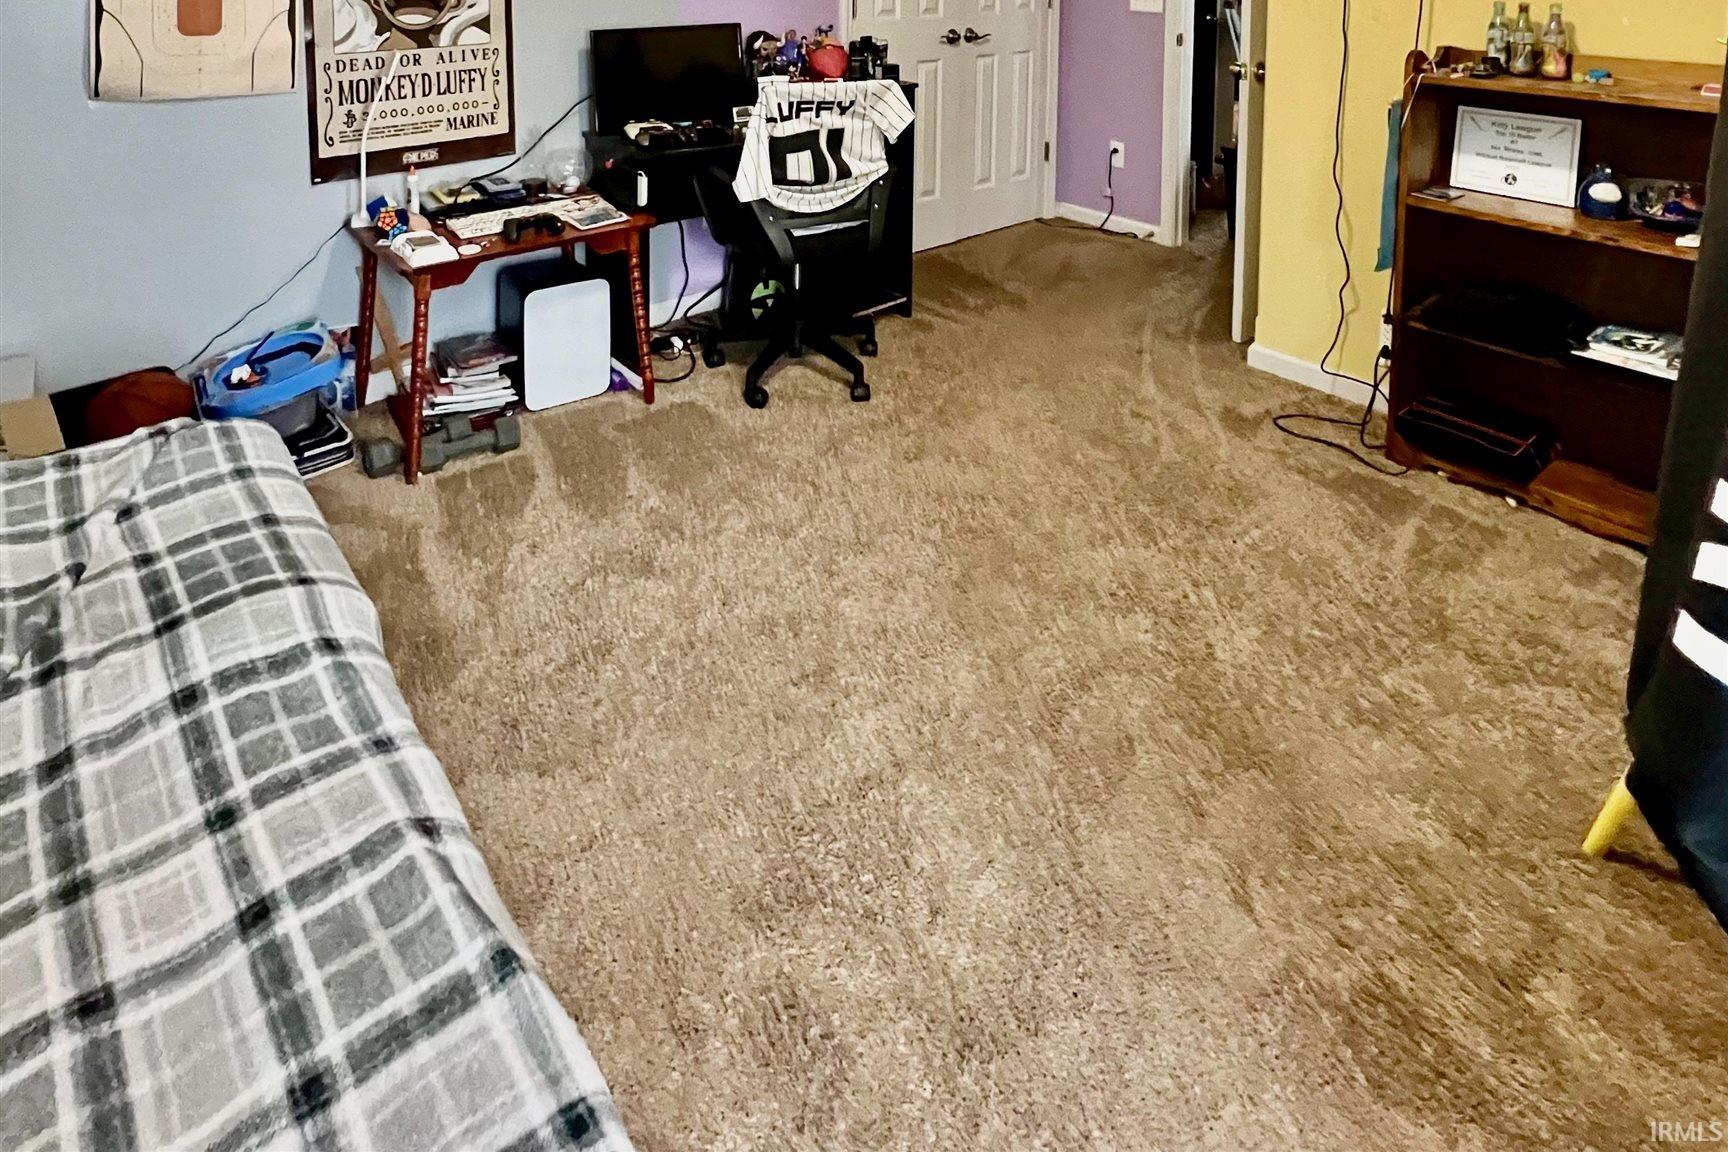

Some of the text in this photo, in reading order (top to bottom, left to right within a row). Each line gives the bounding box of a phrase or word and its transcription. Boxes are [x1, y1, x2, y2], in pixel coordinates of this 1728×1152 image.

[335, 48, 491, 73] DEAD OR ALIVE
[446, 111, 499, 132] MARINE
